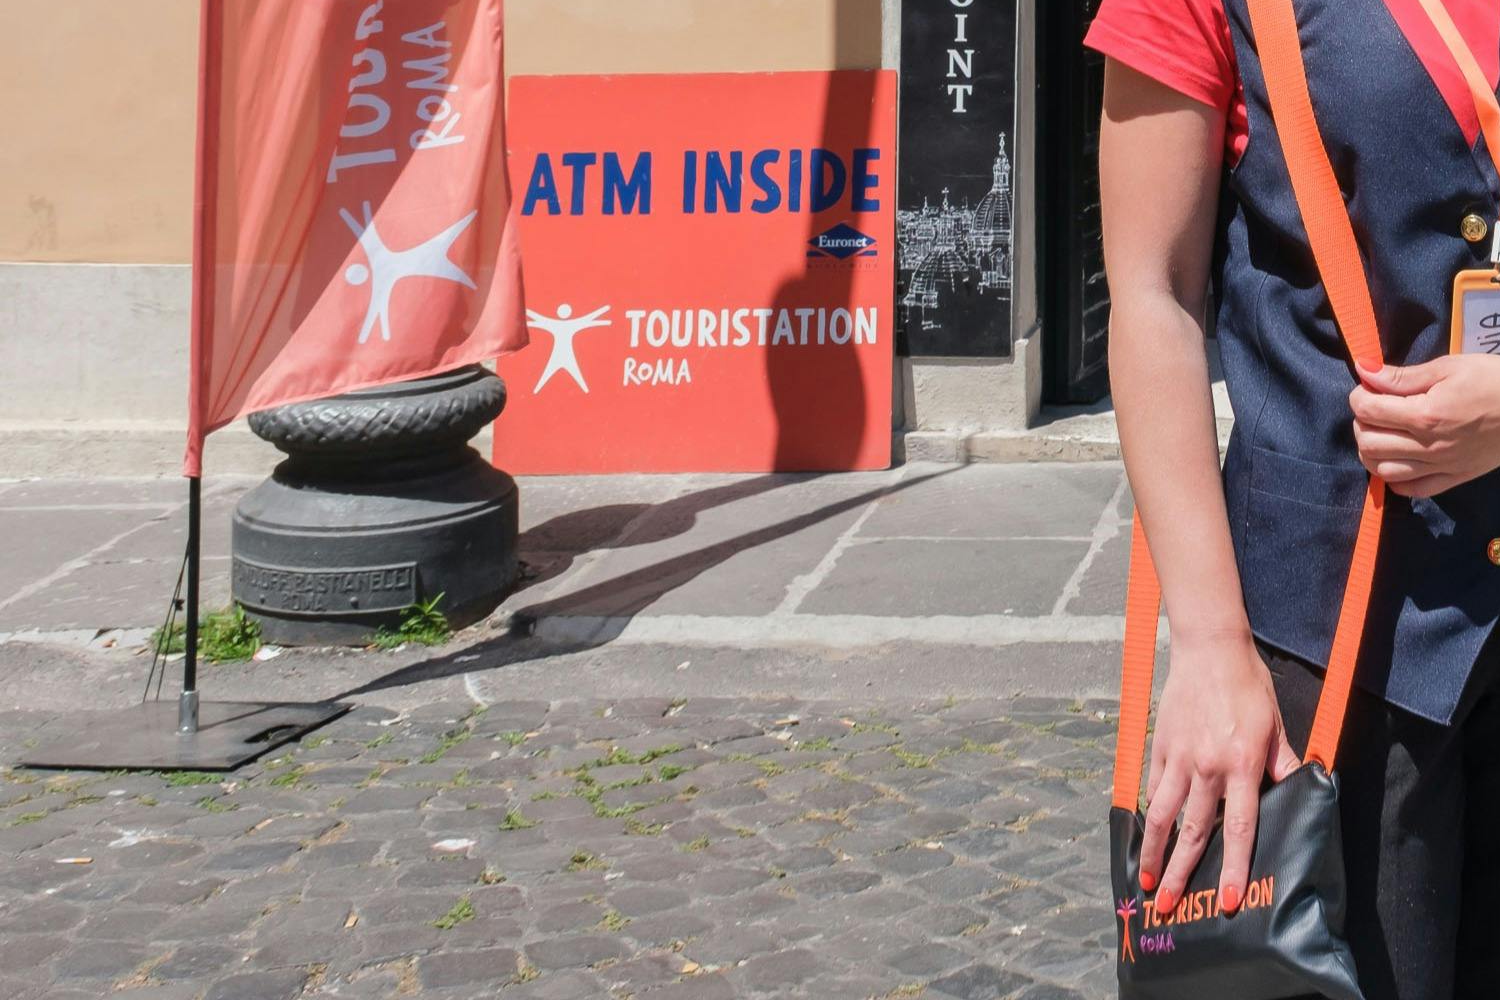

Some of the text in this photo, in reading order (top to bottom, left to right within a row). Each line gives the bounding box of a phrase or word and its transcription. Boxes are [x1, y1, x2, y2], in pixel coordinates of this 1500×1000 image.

[521, 149, 881, 216] ATM INSIDE
[818, 235, 868, 248] Euronet
[625, 307, 878, 348] TOURISTATION
